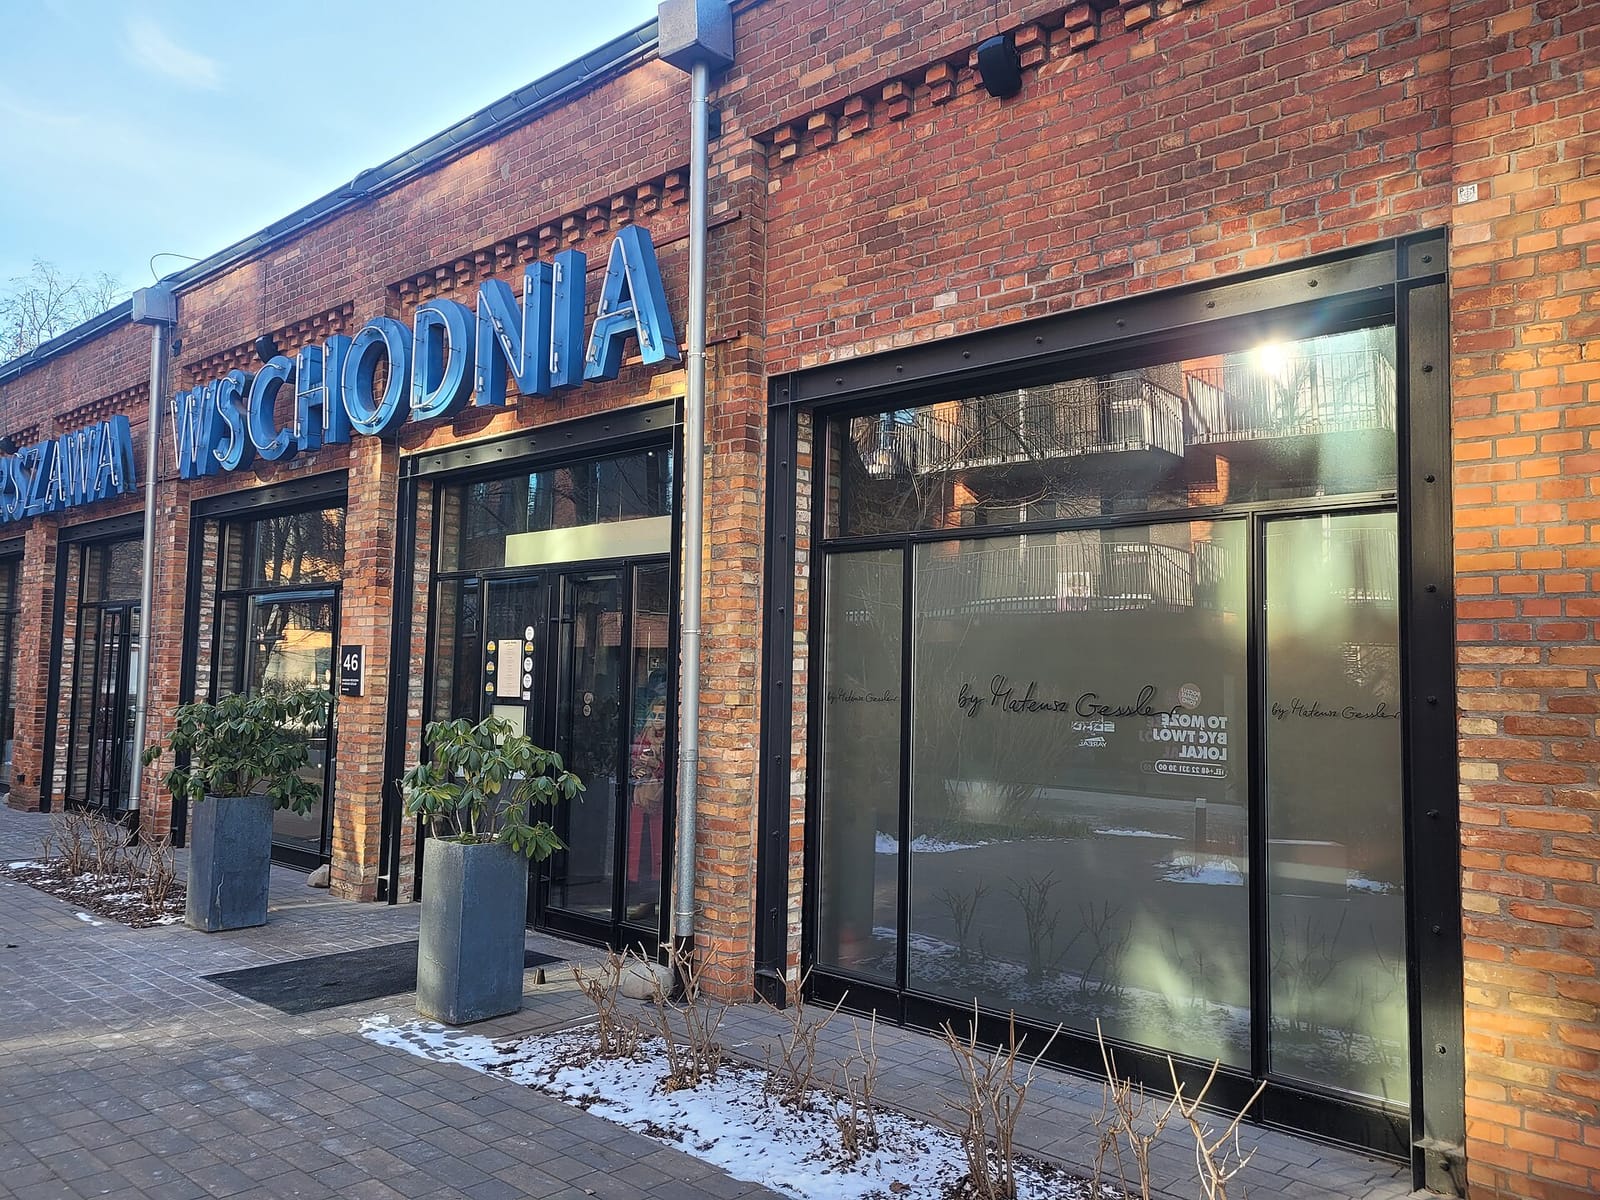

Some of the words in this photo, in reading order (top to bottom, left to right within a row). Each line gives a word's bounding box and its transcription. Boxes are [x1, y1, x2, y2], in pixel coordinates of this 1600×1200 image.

[171, 224, 681, 479] WSCHODNIA
[343, 654, 359, 671] 46
[958, 683, 984, 717] by
[990, 674, 1067, 712] Mateusz
[1075, 685, 1182, 718] Gessler
[1271, 702, 1288, 720] by
[1291, 698, 1337, 717] Mateusz
[1341, 702, 1400, 719] Gessler
